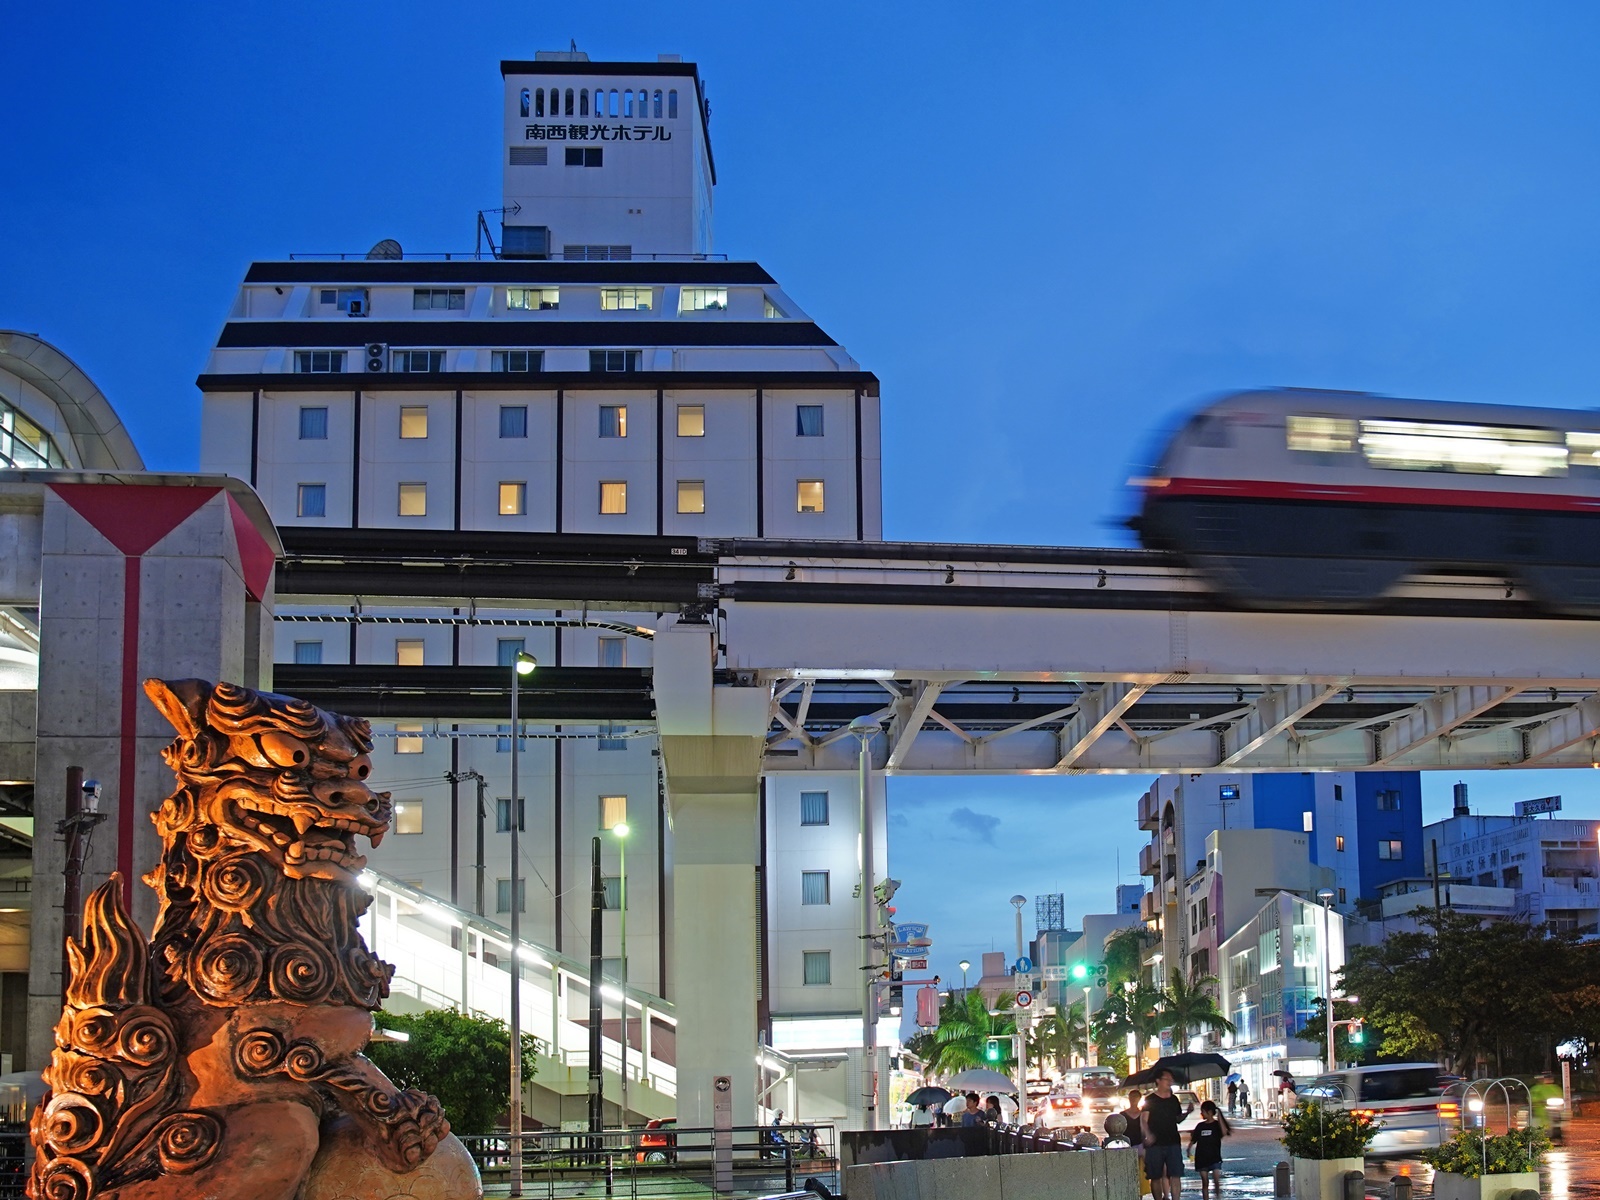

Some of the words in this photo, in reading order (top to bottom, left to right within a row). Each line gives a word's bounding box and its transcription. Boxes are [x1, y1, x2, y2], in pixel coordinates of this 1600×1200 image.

[525, 123, 672, 141] 南西観光ホテル
